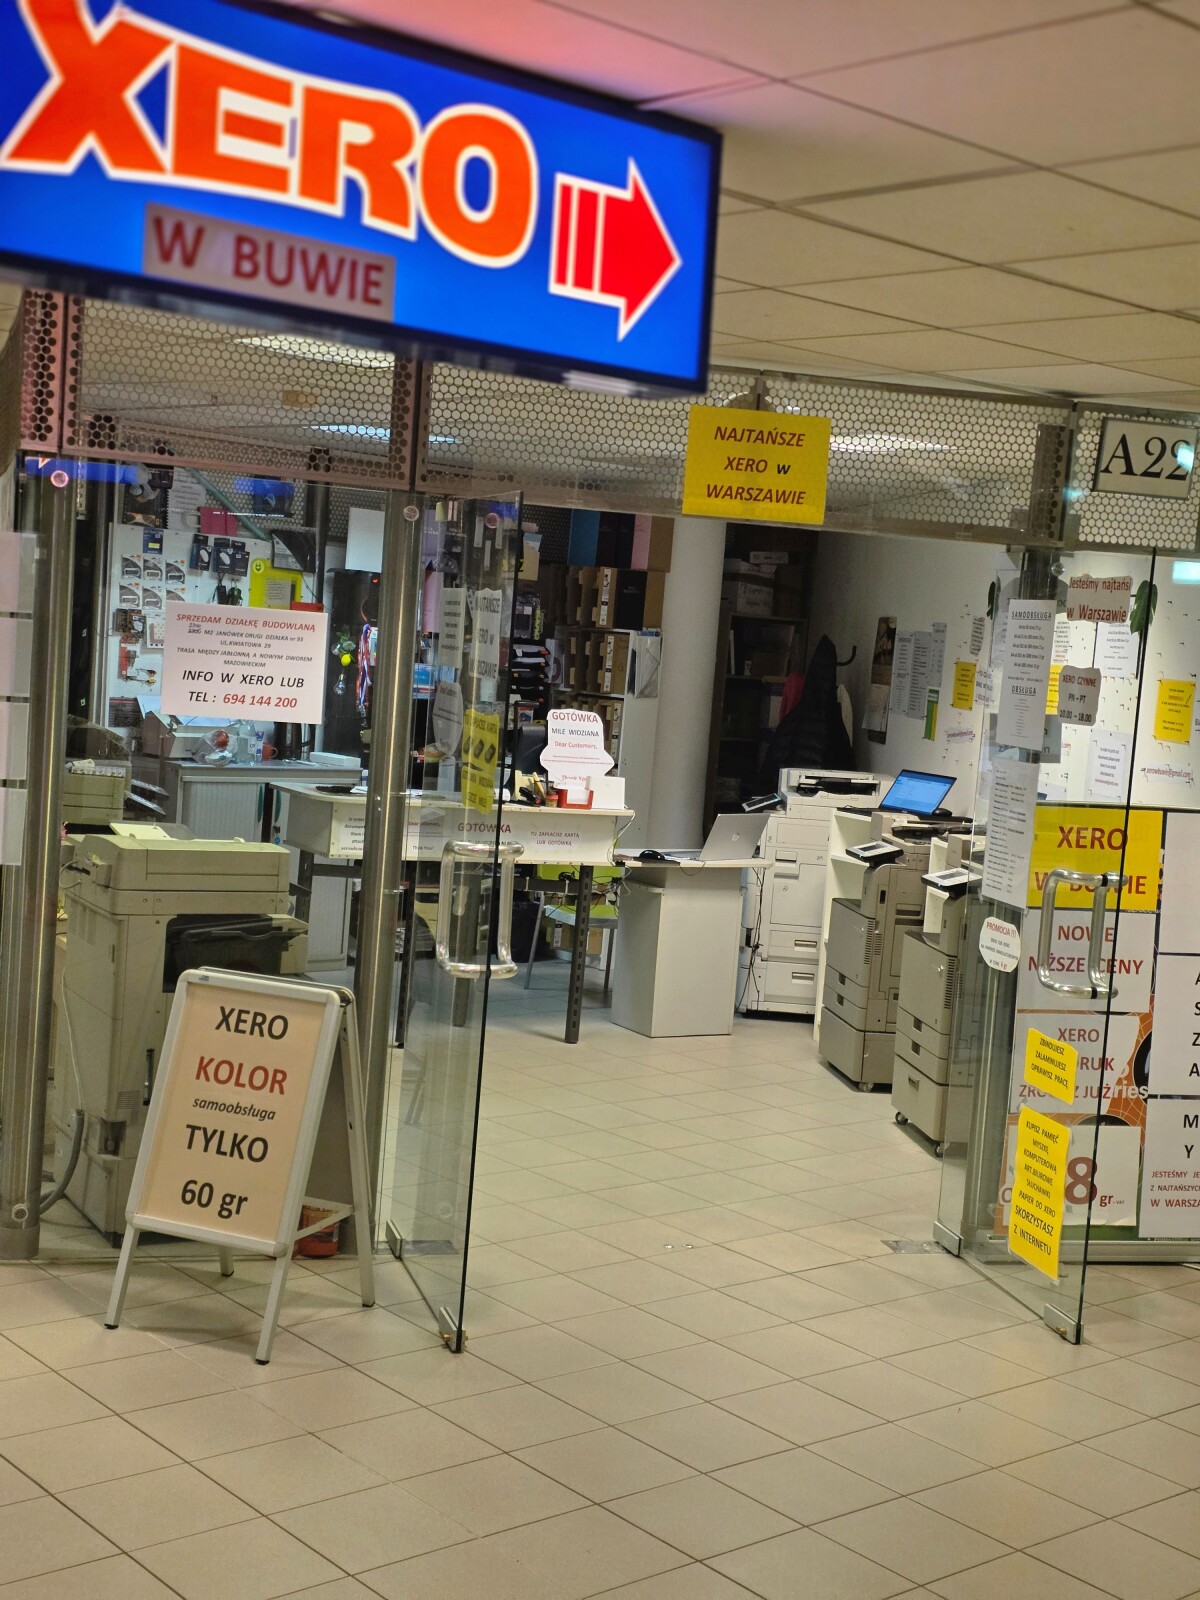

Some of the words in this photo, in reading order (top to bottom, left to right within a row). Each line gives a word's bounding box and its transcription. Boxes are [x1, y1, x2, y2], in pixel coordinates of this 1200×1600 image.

[0, 0, 538, 268] XERO
[152, 216, 204, 267] W
[232, 235, 385, 306] BUWIE
[714, 426, 806, 447] NAJTAŃSZE
[724, 456, 768, 473] XERO
[1100, 434, 1192, 481] A22
[706, 484, 806, 504] WARSZAWIE
[1069, 577, 1099, 592] Jesteśmy
[1102, 578, 1131, 592] najtańsi
[1012, 610, 1052, 619] SAMOOBSŁUGA
[1079, 604, 1127, 622] Warszawie
[176, 614, 222, 624] SPRZEDAM
[226, 617, 258, 628] DZIAŁKĘ
[262, 620, 316, 632] BUDOWLANĄ
[182, 670, 214, 682] INFO
[221, 673, 234, 683] W
[240, 674, 274, 686] XERO
[280, 677, 304, 688] LUB
[1062, 674, 1075, 684] XERO
[1077, 676, 1096, 687] CZYNNE
[1012, 685, 1036, 694] OBSŁUGA
[1068, 693, 1075, 701] PN
[1080, 694, 1086, 703] PT
[188, 691, 208, 702] TEL
[223, 694, 246, 704] 694
[249, 696, 271, 706] 144
[274, 698, 298, 708] 200
[552, 711, 598, 723] GOTÓWKA
[568, 729, 600, 737] WIDZIANA
[1057, 826, 1128, 850] XERO
[987, 922, 1010, 936] PROMOCJA
[1028, 953, 1086, 972] NŻSZE
[214, 1006, 288, 1040] XERO
[1058, 1028, 1100, 1042] XERO
[1036, 1051, 1066, 1071] ZALAMINUJESZ
[1189, 1063, 1200, 1077] A
[195, 1056, 287, 1095] KOLOR
[1031, 1063, 1052, 1080] OPRAWISZ
[1054, 1074, 1068, 1090] PRACĘ
[1082, 1084, 1111, 1099] JUŻ
[192, 1097, 276, 1121] samoobsługa
[1183, 1114, 1200, 1129] M
[1026, 1120, 1040, 1134] KUPISZ
[1042, 1129, 1059, 1144] PAMIĘĆ
[186, 1124, 268, 1163] TYLKO
[1032, 1138, 1049, 1156] MYSZKĘ
[1185, 1145, 1194, 1159] Y
[1023, 1149, 1057, 1175] KOMPUTEROWĄ
[1066, 1157, 1098, 1205] 8
[1100, 1194, 1114, 1207] gr
[1152, 1170, 1188, 1178] JESTEŚMY
[1026, 1178, 1050, 1199] SŁUCHAWKI
[180, 1180, 214, 1208] 60
[218, 1190, 248, 1220] gr
[1019, 1190, 1034, 1205] PAPIER
[1035, 1200, 1042, 1210] DO
[1044, 1205, 1056, 1218] XERO
[1150, 1199, 1160, 1207] W
[1015, 1205, 1054, 1236] SKORZYSTASZ
[1013, 1224, 1018, 1234] Z
[1019, 1229, 1051, 1256] INTERNETU
